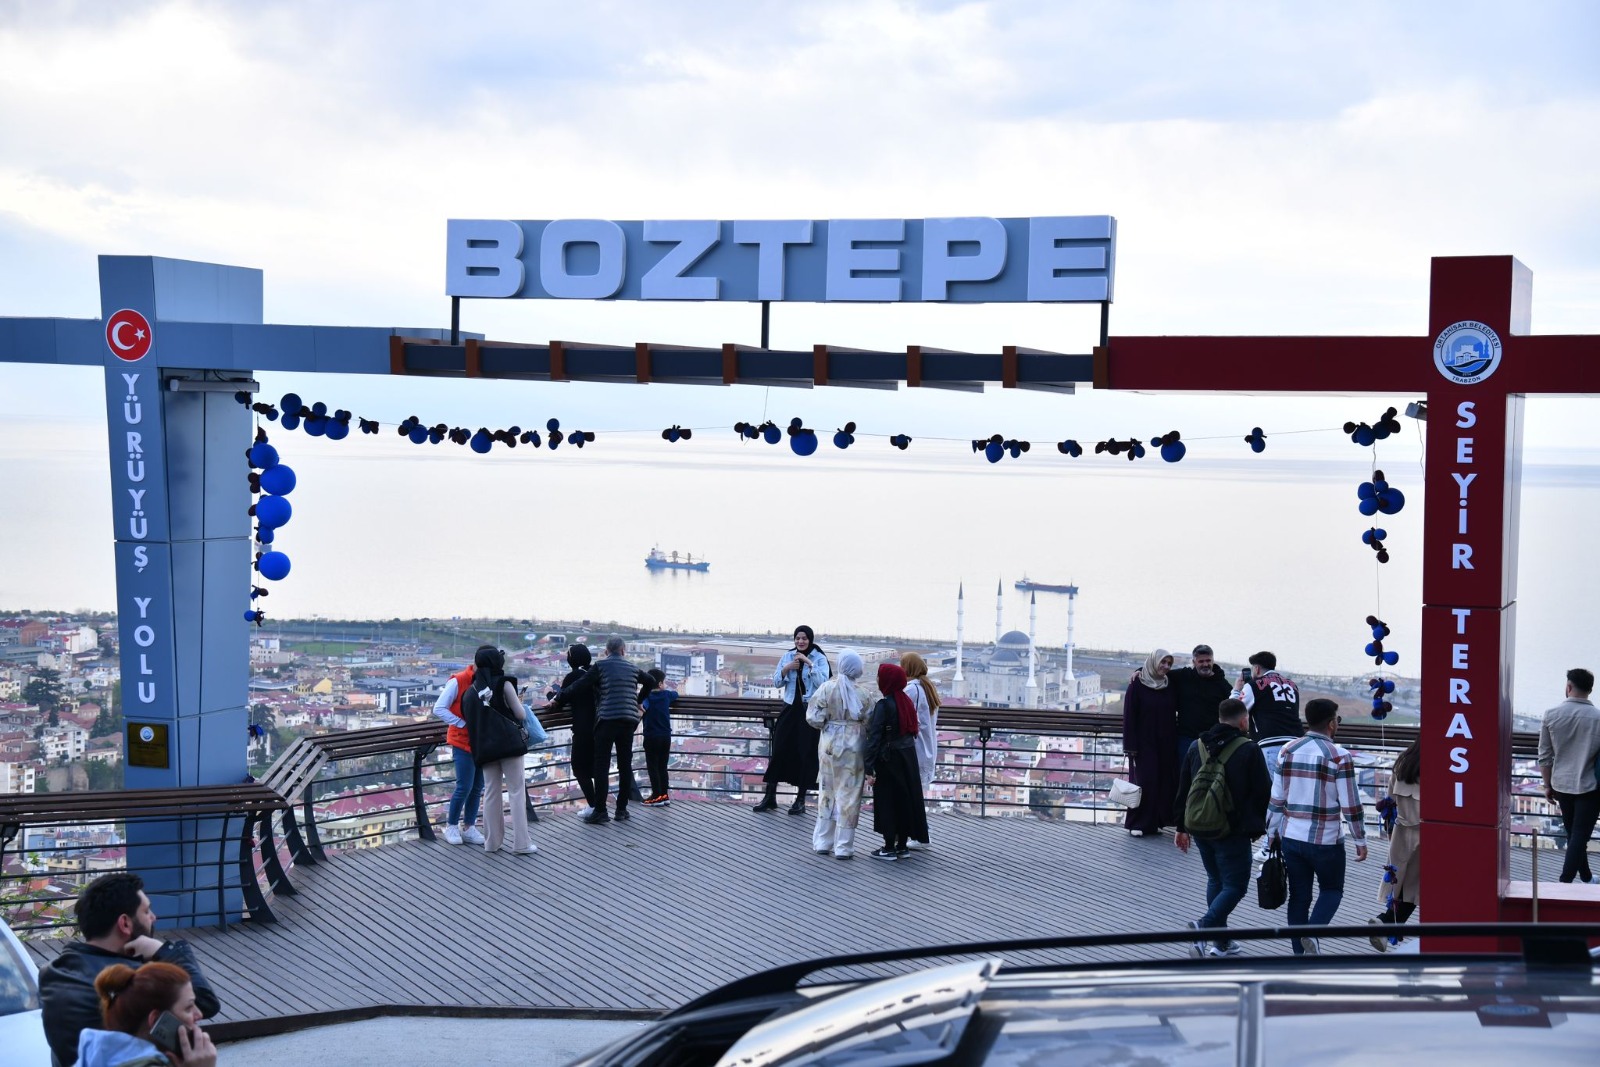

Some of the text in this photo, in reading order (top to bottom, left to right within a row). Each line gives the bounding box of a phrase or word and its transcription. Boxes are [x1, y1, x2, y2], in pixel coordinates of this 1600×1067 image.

[446, 215, 1111, 302] BOZTEPE
[1452, 375, 1481, 383] TRABZON
[121, 373, 156, 703] YÜRÜYÜŞ YOLU
[1445, 401, 1478, 807] SEYİR TERASI
[1269, 681, 1297, 703] 23
